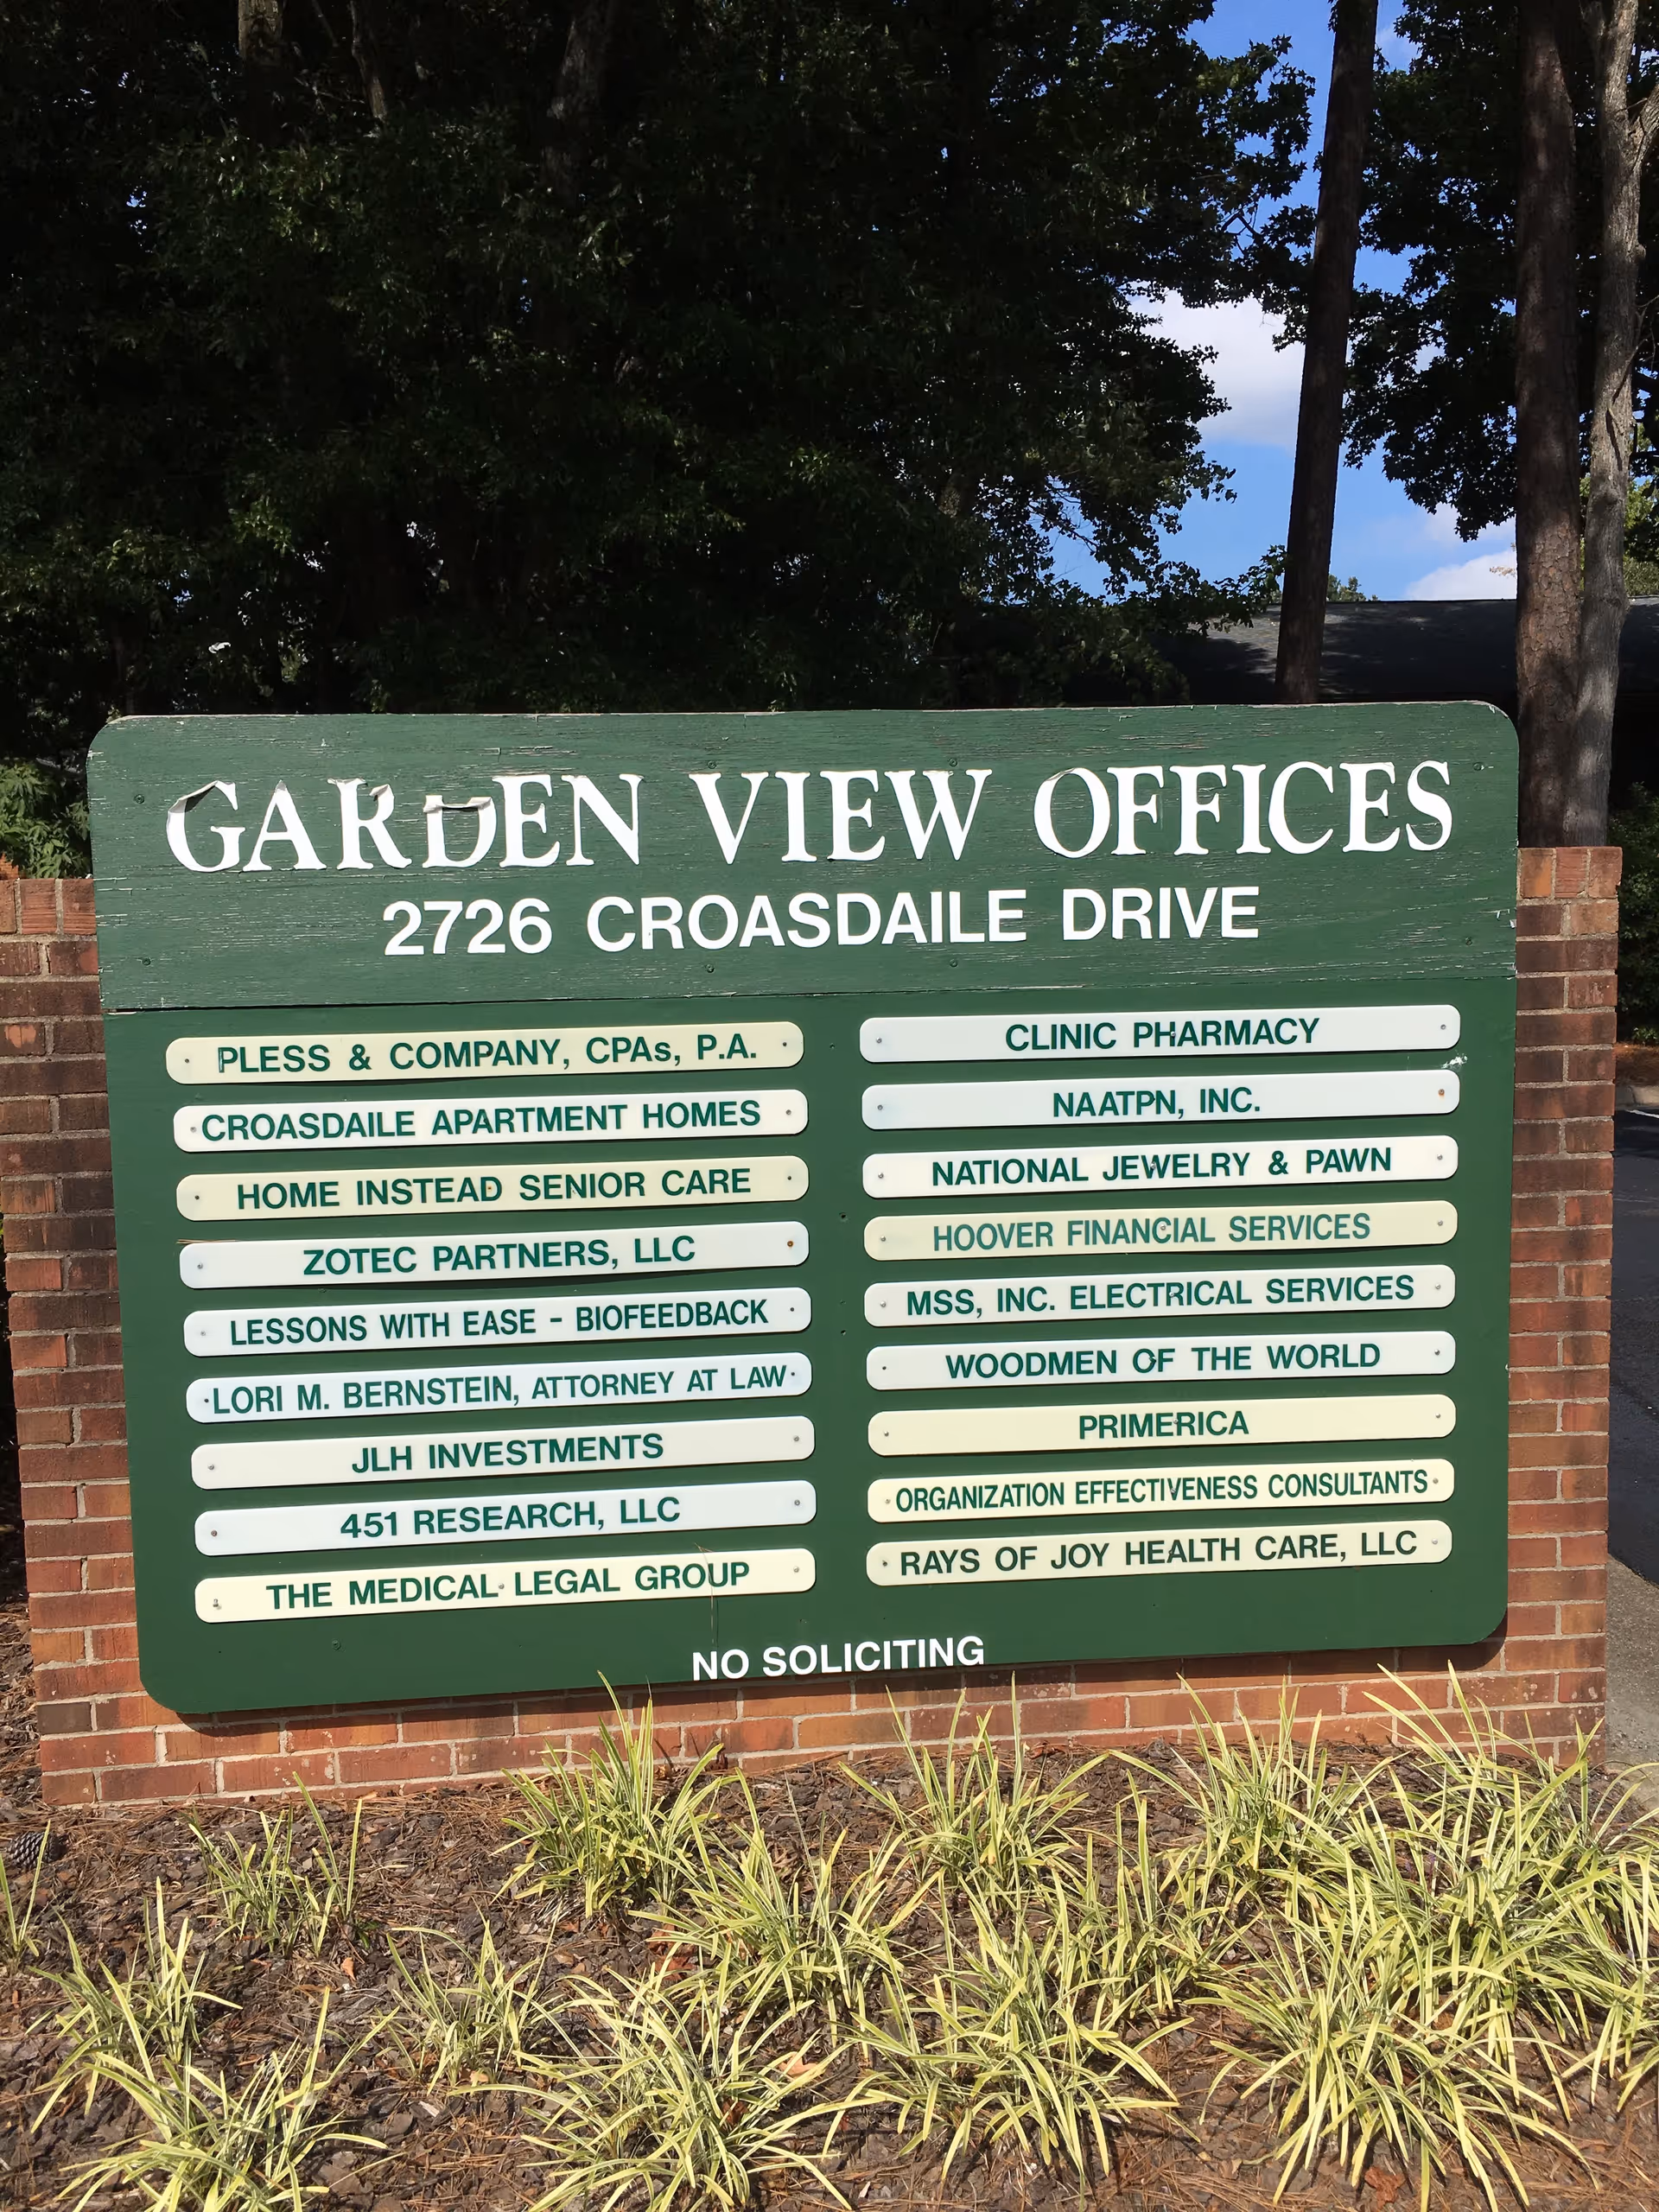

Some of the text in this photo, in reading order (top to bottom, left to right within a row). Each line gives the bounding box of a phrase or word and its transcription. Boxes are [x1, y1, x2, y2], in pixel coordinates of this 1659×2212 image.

[167, 760, 1452, 872] GARDEN VIEW OFFICES
[384, 887, 1259, 955] 2726 CROASDAILE DRIVE
[218, 1033, 756, 1072] PLESS & COMPANY, CPAs, P.A.
[1006, 1018, 1319, 1051] CLINIC PHARMACY
[202, 1100, 760, 1141] CROASDAILE APARTMENT HOMES
[1054, 1087, 1260, 1118] NAATPN, INC.
[933, 1147, 1390, 1185] NATIONAL JEWELRY & PAWN
[238, 1168, 751, 1209] HOME INSTEAD SENIOR CARE
[934, 1213, 1370, 1251] HOOVER FINANCIAL SERVICES
[304, 1236, 695, 1274] ZOTEC PARTNERS, LLC
[907, 1274, 1414, 1319] MSS, INC. ELECTRICAL SERVICES
[231, 1315, 366, 1345] LESSONS
[380, 1313, 449, 1338] WITH
[464, 1309, 536, 1336] EASE
[576, 1300, 768, 1331] BIOFEEDBACK
[946, 1344, 1380, 1378] WOODMEN OF THE WORLD
[213, 1365, 786, 1414] LORI M. BERNSTEIN, ATTORNEY AT LAW
[1080, 1411, 1249, 1439] PRIMERICA
[353, 1433, 664, 1473] JLH INVESTMENTS
[896, 1470, 1427, 1512] ORGANIZATION EFFECTIVENESS CONSULTANTS
[340, 1497, 679, 1538] 451 RESEARCH, LLC
[901, 1530, 1417, 1575] RAYS OF JOY HEALTH CARE, LLC
[266, 1562, 749, 1609] THE MEDICAL LEGAL GROUP
[693, 1637, 983, 1681] NO SOLICITING
